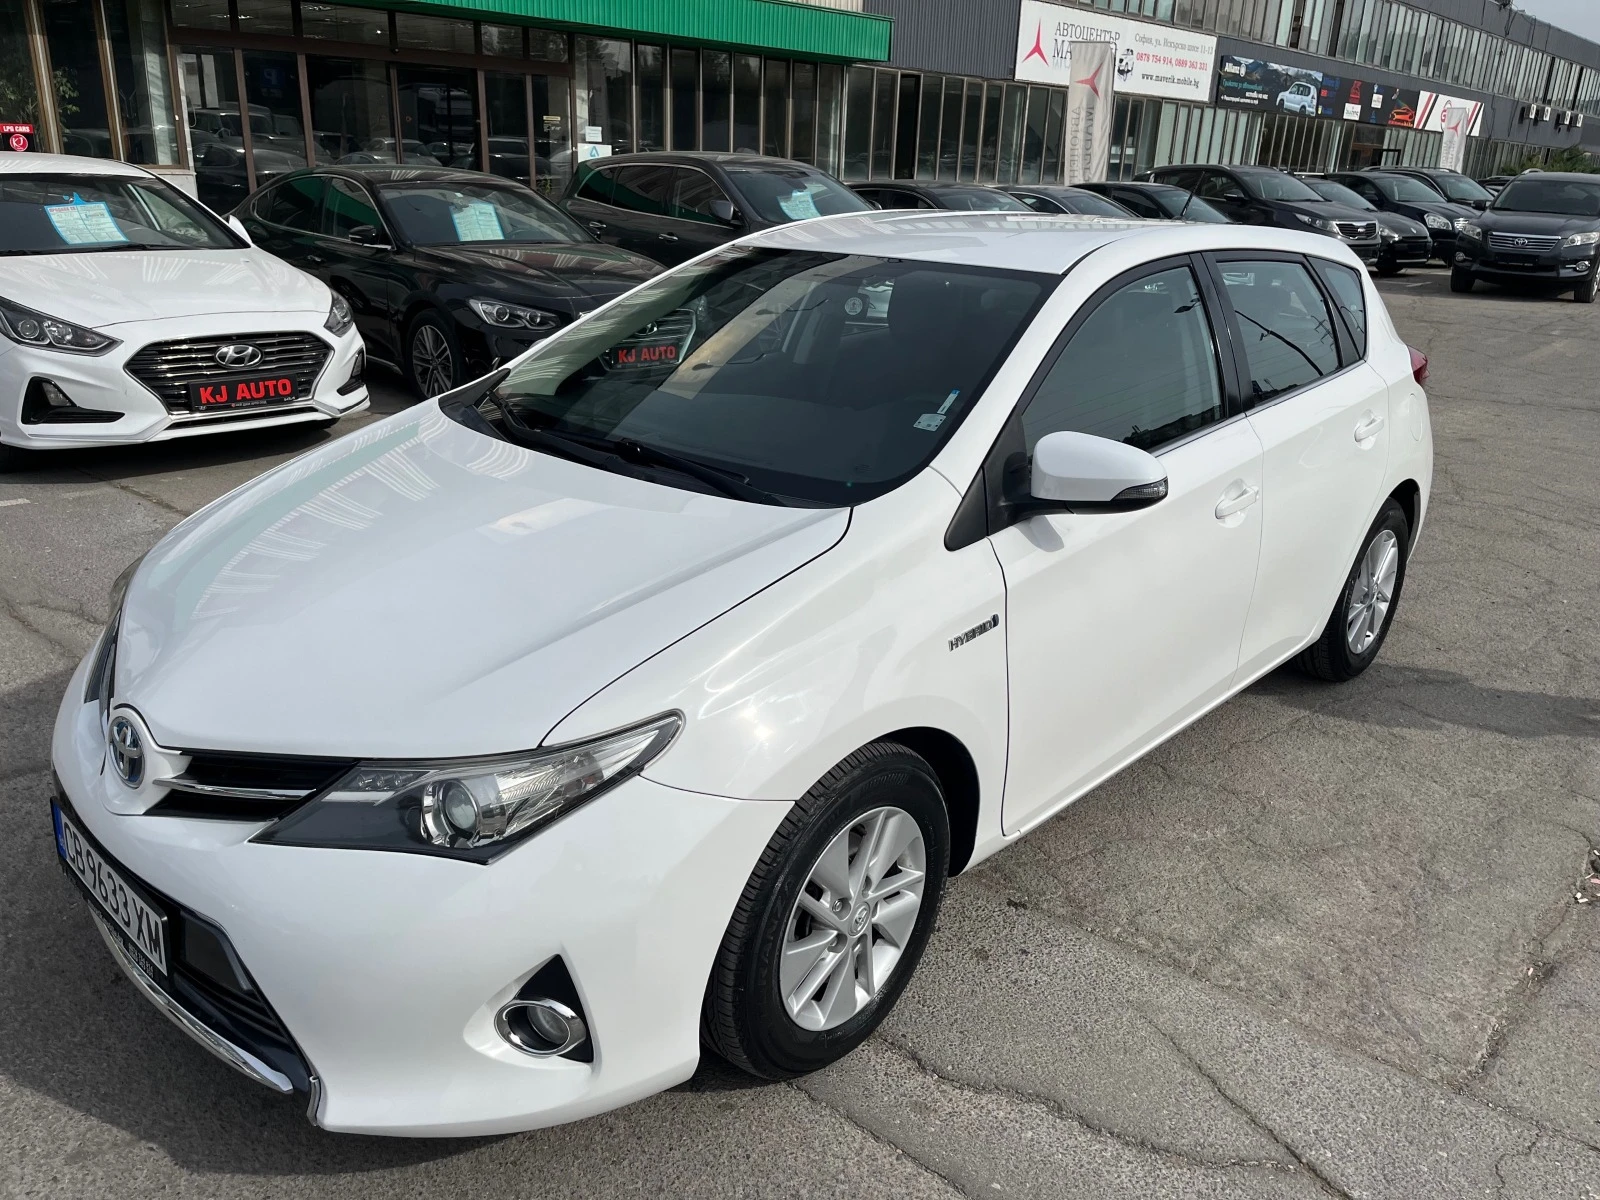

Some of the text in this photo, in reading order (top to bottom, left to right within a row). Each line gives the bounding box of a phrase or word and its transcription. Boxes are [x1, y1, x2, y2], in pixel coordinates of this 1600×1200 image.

[1054, 22, 1121, 42] АВТОЦЕНТЪР
[1134, 32, 1154, 46] София,
[1136, 52, 1151, 63] 0878
[1151, 54, 1162, 64] 754
[1174, 58, 1188, 68] 0889
[1141, 73, 1200, 89] www.maverik.mobile.bg
[618, 345, 676, 363] KJ AUTO
[200, 378, 292, 404] KJ AUTO
[947, 619, 993, 652] HYBRID
[85, 848, 131, 928] 9633
